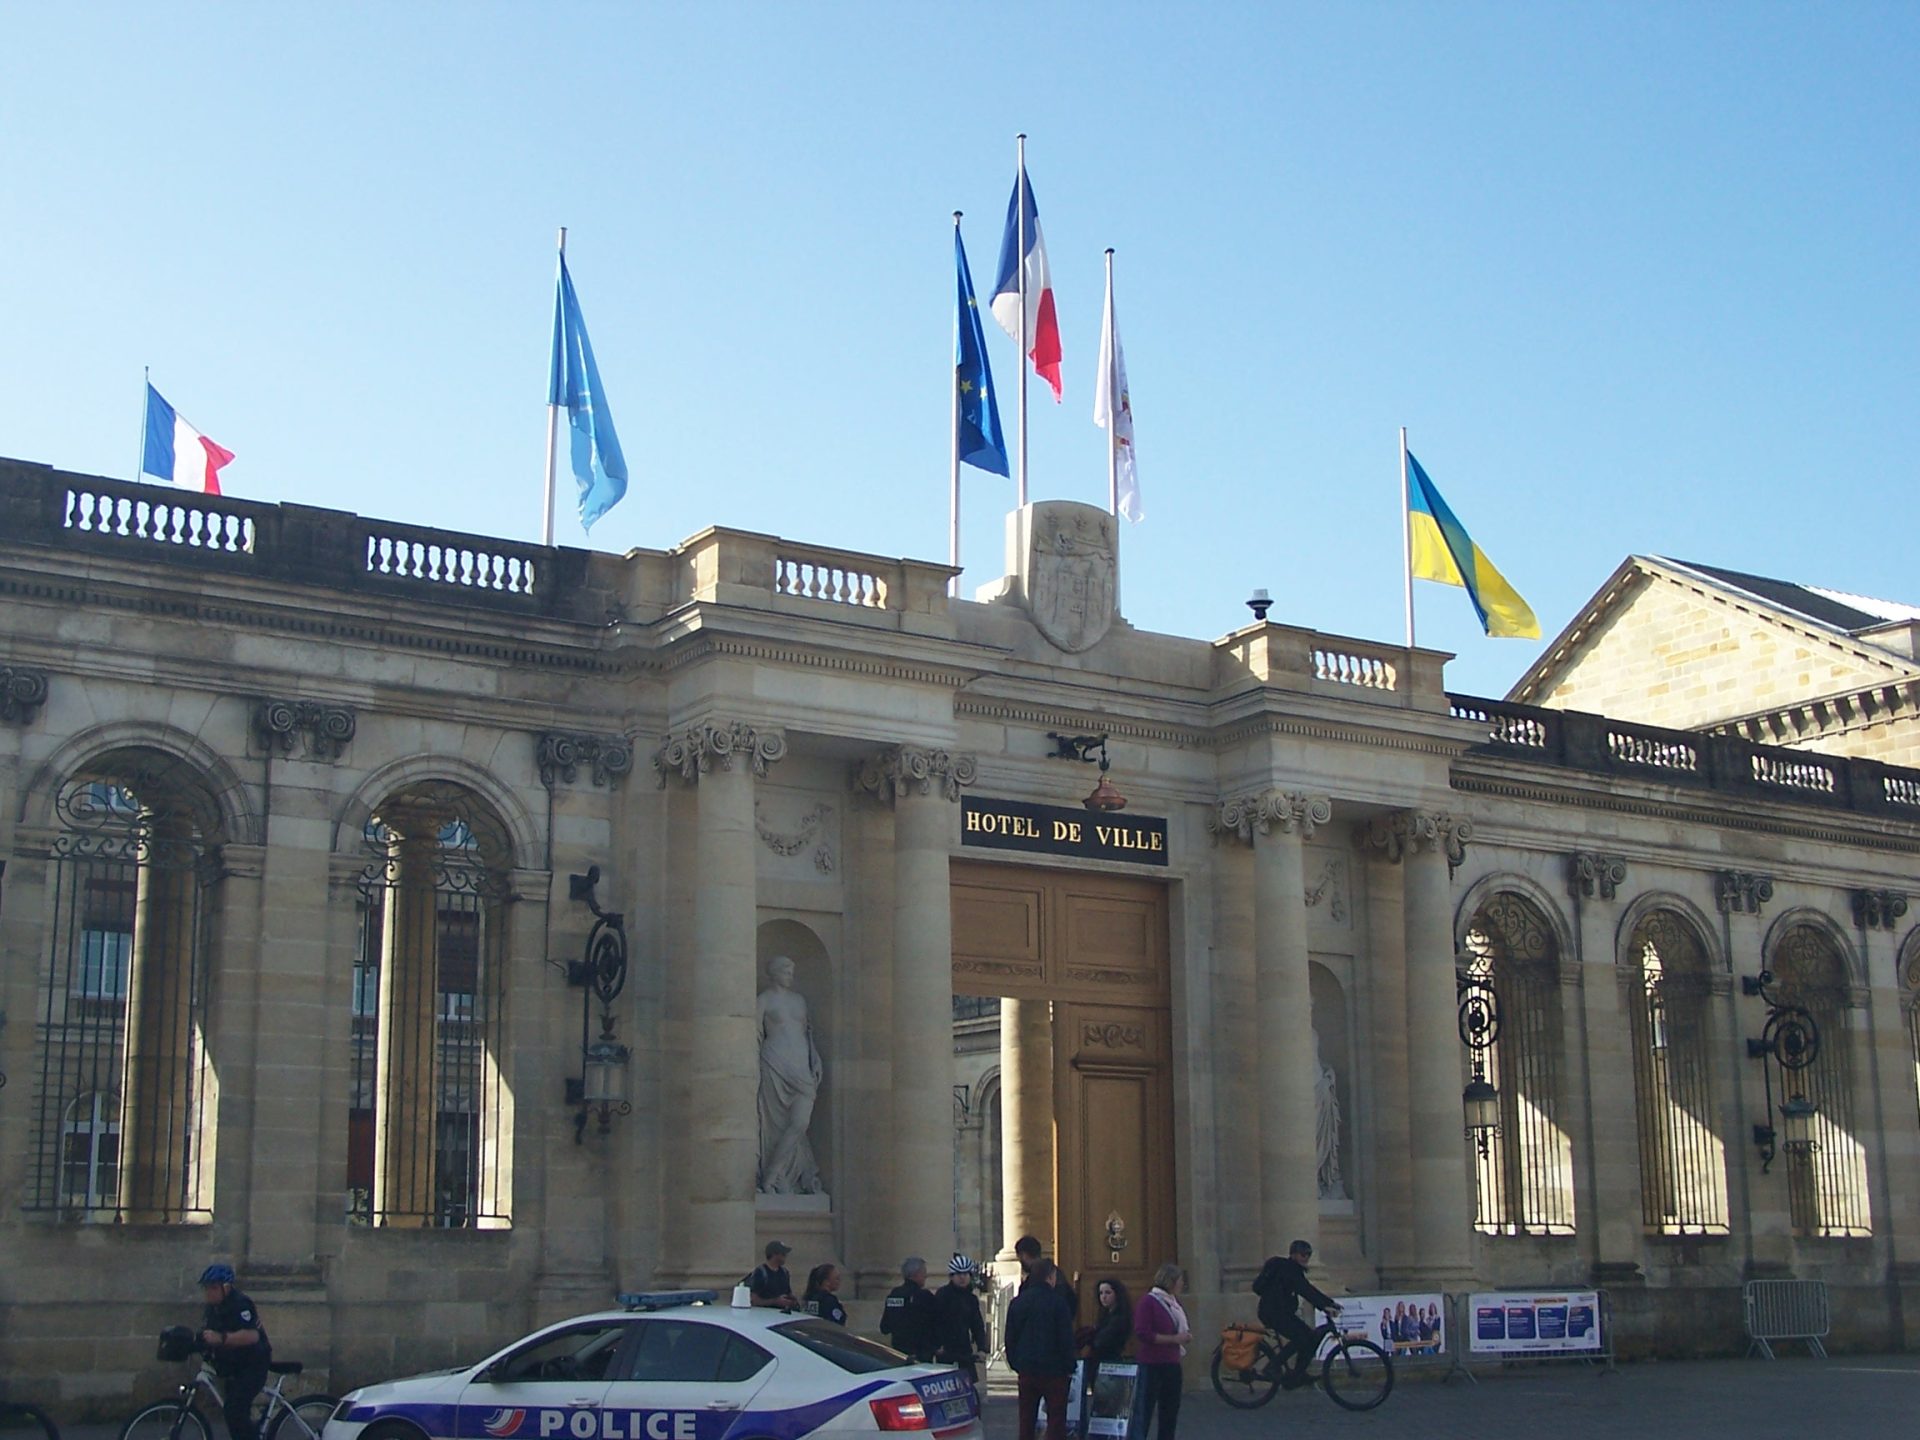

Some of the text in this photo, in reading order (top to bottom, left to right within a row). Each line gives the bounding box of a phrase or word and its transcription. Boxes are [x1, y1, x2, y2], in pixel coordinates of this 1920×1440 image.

[966, 811, 1163, 851] HOTEL DE VILLE
[922, 1379, 956, 1397] POLICE
[540, 1410, 697, 1440] POLICE
